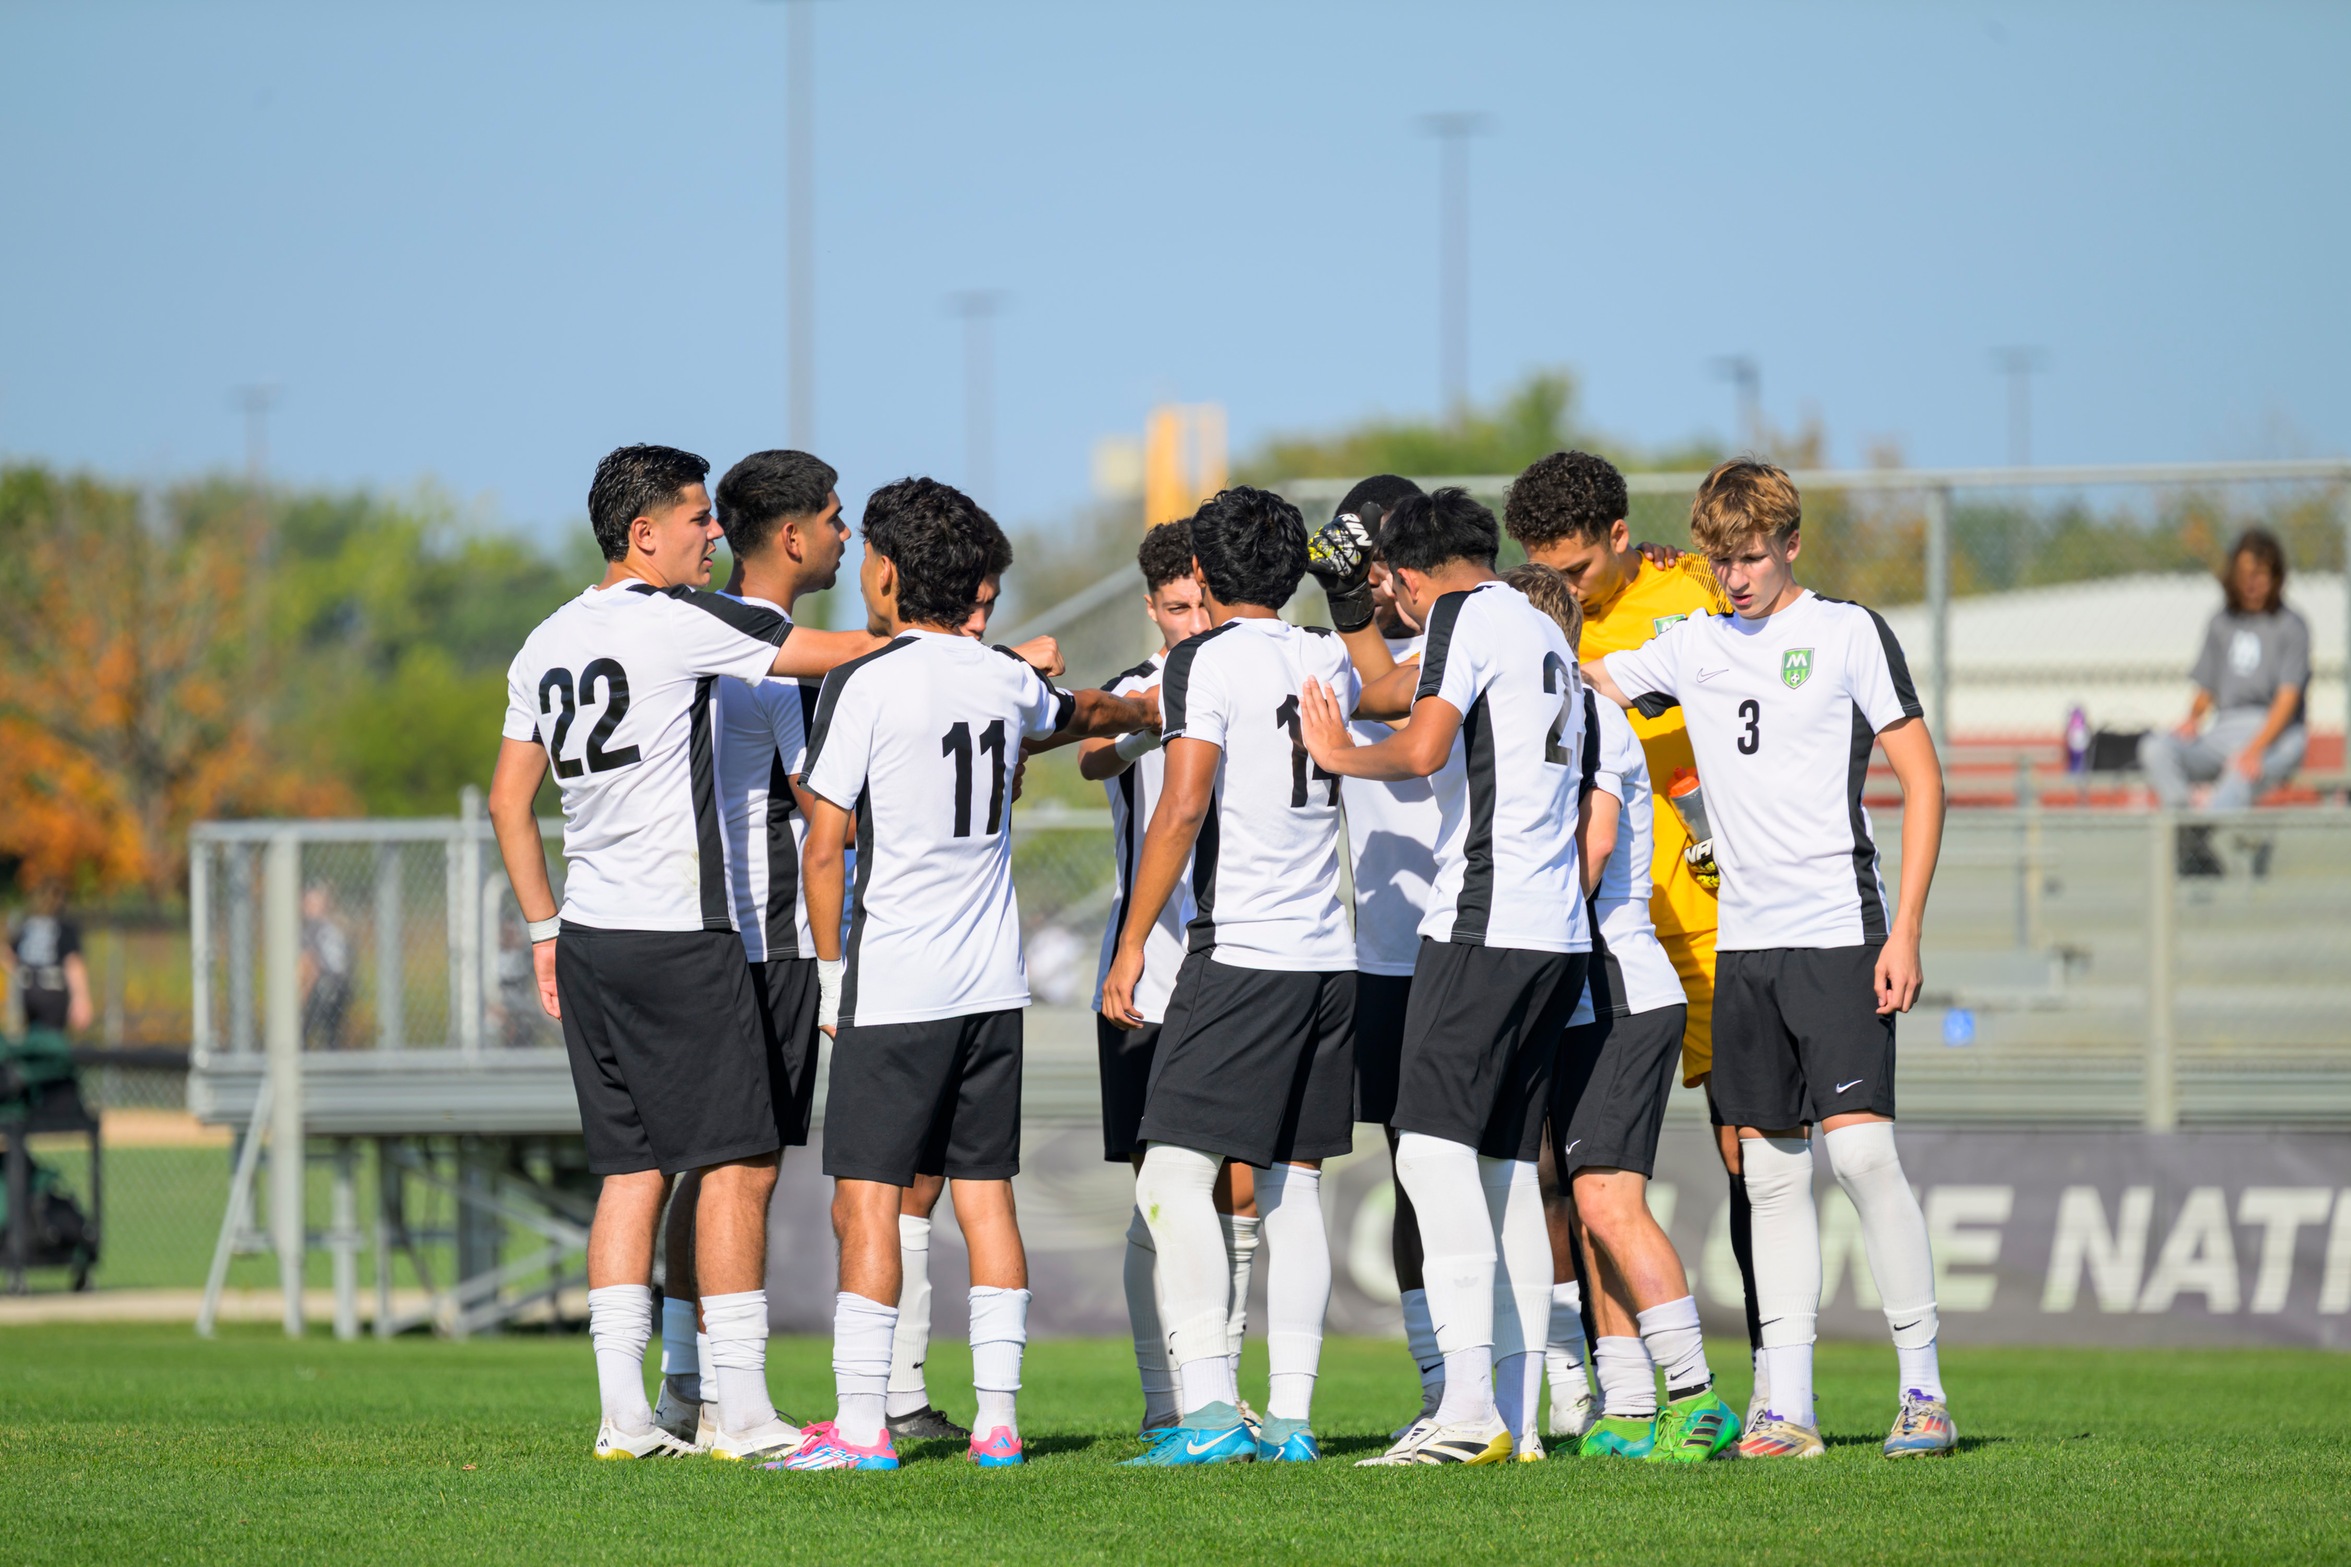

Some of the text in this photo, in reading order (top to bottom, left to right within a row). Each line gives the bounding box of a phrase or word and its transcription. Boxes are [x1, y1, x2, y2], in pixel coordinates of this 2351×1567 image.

[538, 657, 642, 779] 22
[1737, 698, 1760, 755] 3
[941, 719, 1006, 838] 11
